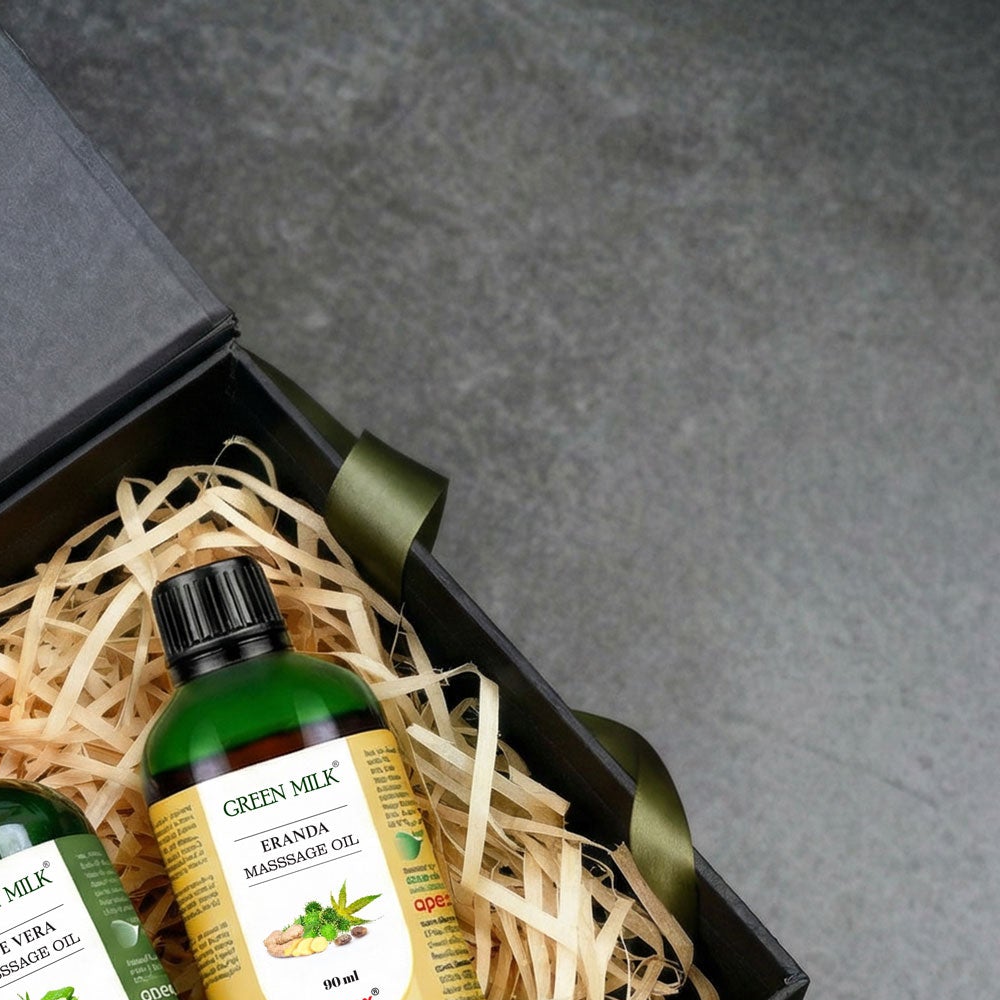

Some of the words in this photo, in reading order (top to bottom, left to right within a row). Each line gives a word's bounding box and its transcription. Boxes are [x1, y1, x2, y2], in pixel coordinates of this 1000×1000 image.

[224, 784, 286, 816] GREEN
[261, 823, 329, 852] ERANDA
[244, 844, 327, 879] MASSSAGE
[332, 835, 359, 850] OIL
[11, 922, 56, 946] VERA
[53, 934, 80, 951] OIL
[324, 977, 340, 990] 90
[343, 970, 359, 984] ml
